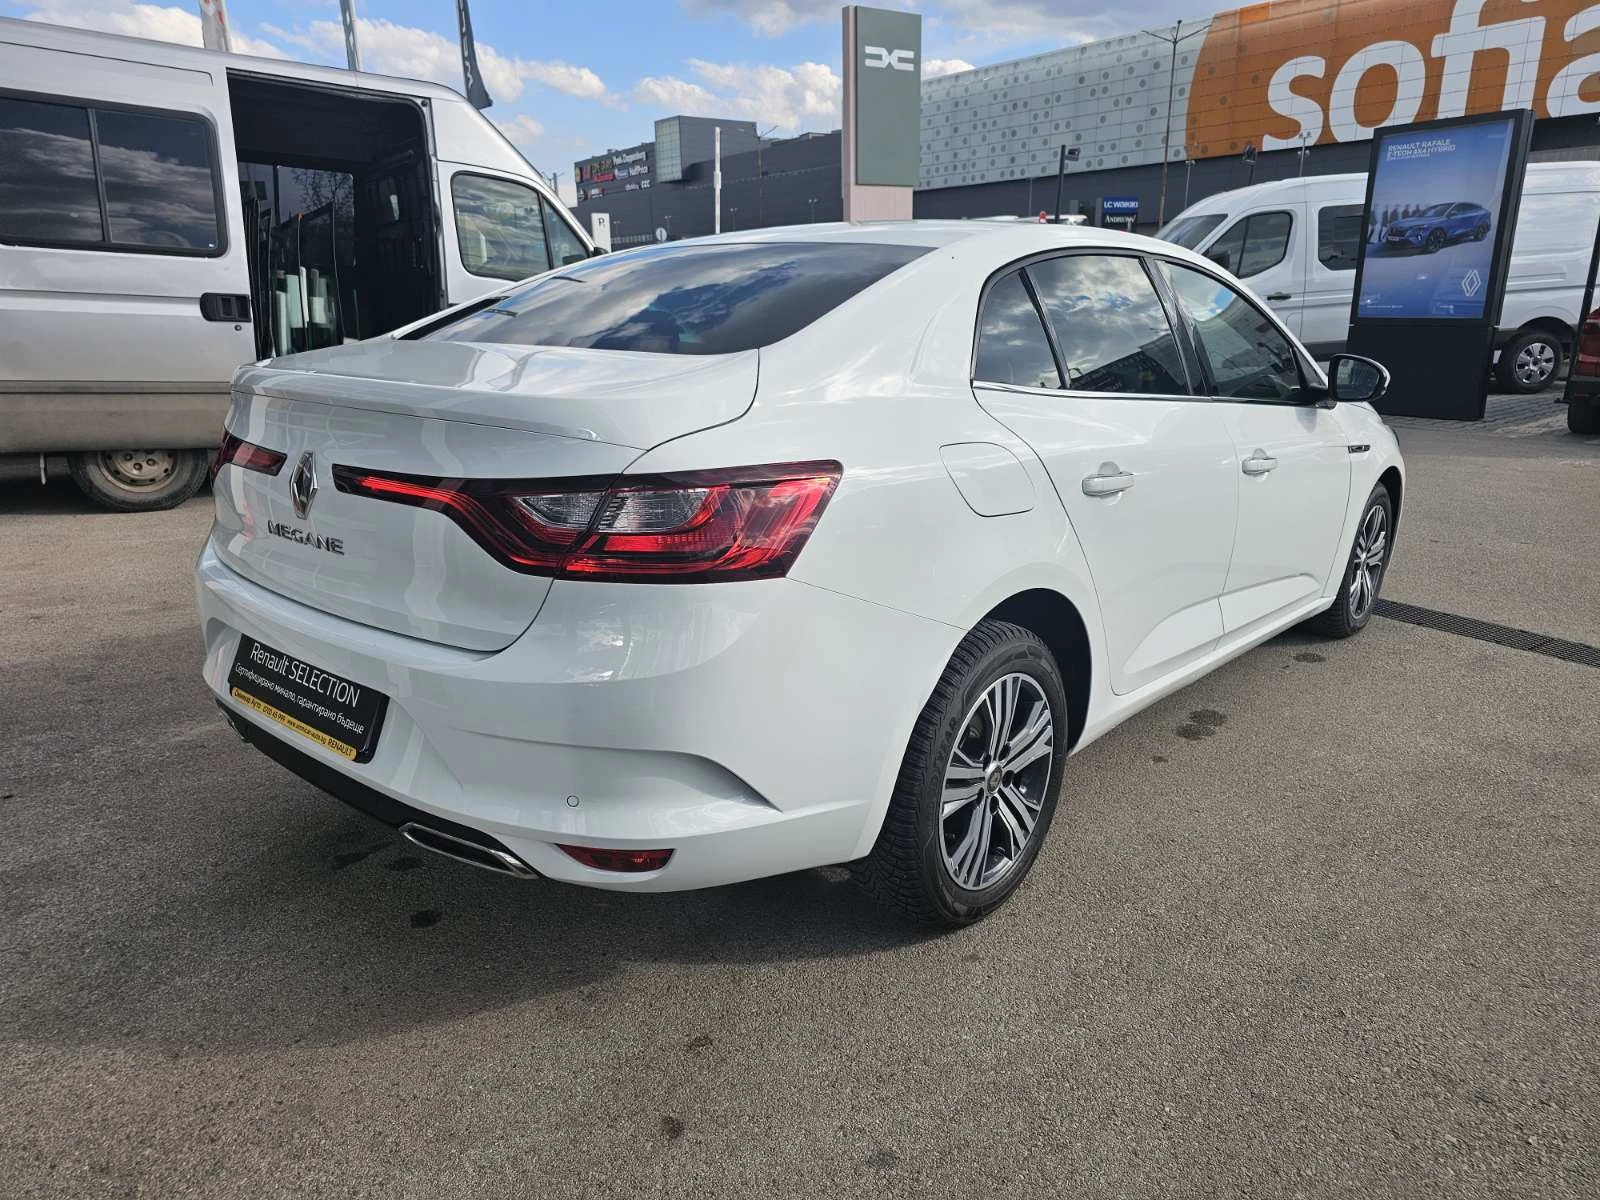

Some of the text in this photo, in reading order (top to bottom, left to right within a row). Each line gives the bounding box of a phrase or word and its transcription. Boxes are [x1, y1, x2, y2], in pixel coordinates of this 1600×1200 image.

[267, 519, 345, 556] MEGANE
[250, 641, 361, 708] Renault SELECTION
[296, 695, 336, 720] гарантирано
[336, 712, 365, 735] бъдеще
[327, 738, 354, 757] RENAULT
